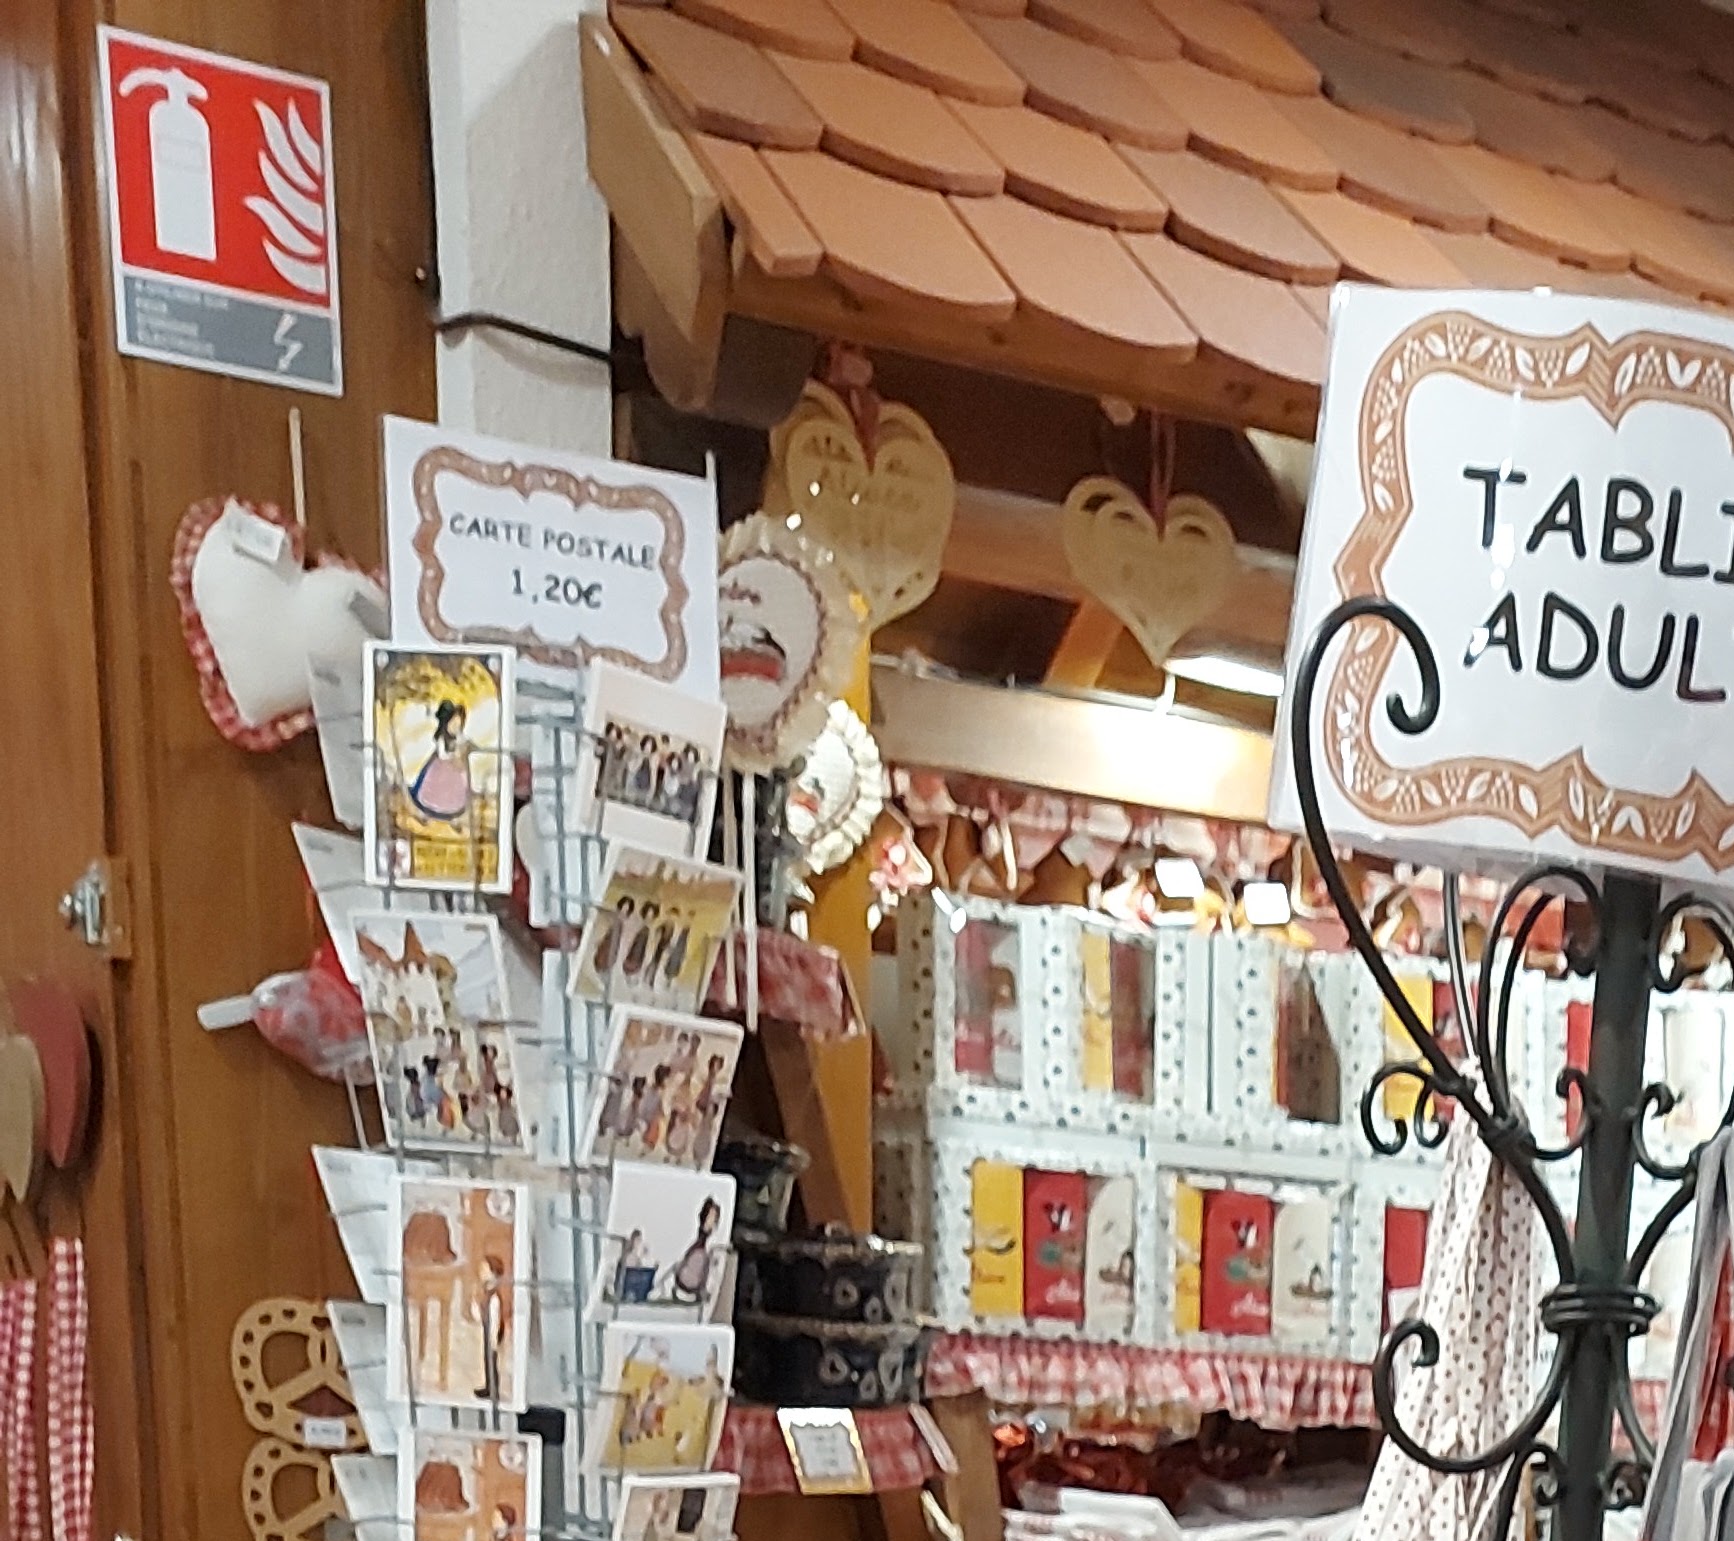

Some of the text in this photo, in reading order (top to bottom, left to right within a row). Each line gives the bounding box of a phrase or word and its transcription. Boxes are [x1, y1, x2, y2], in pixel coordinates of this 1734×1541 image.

[449, 511, 656, 571] CARTE POSTALE
[511, 565, 603, 609] 1,20€
